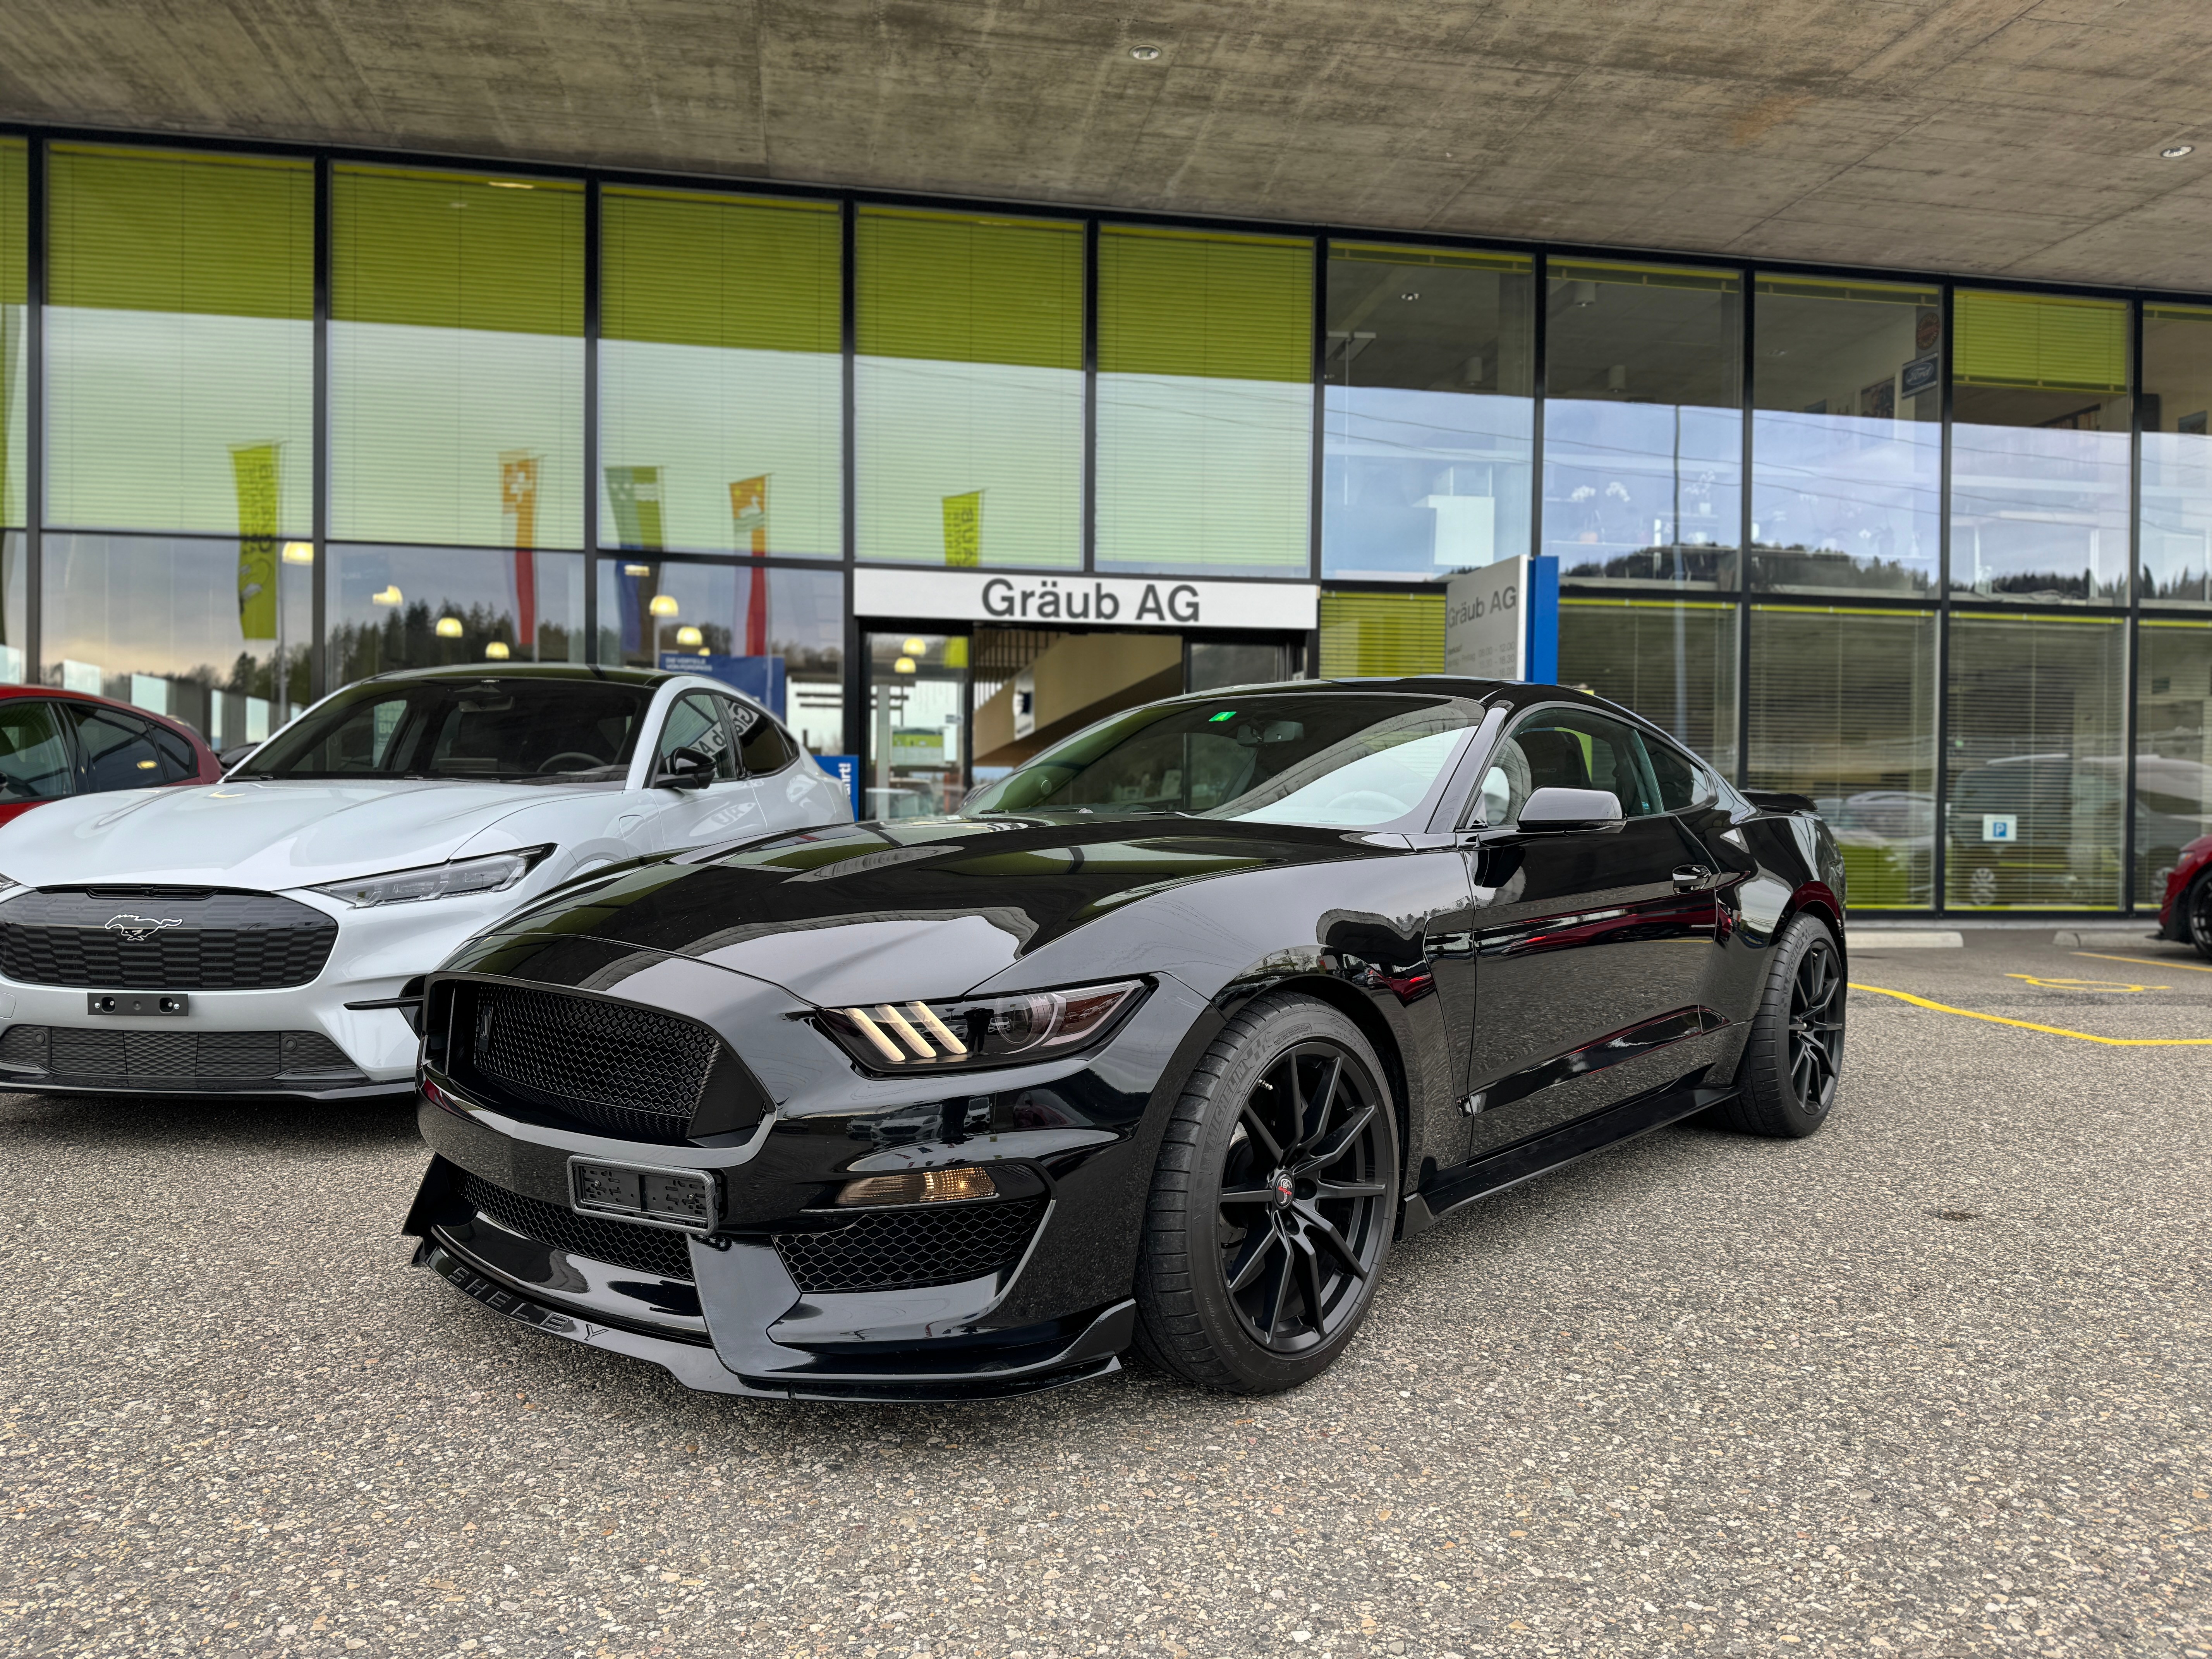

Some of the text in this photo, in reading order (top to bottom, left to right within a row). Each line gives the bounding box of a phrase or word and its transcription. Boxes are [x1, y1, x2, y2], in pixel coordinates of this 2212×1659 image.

[1907, 366, 1932, 382] Ford
[982, 578, 1200, 622] Gräub AG
[1448, 586, 1516, 629] Gräub AG
[1499, 641, 1515, 652] 12.00
[1499, 654, 1515, 664] 18.30
[1499, 666, 1515, 677] 16.00
[1996, 823, 2005, 837] P
[1786, 938, 1803, 981] MICHELIN
[1206, 1061, 1247, 1148] MICHELIN
[447, 1267, 609, 1341] SHELBY
